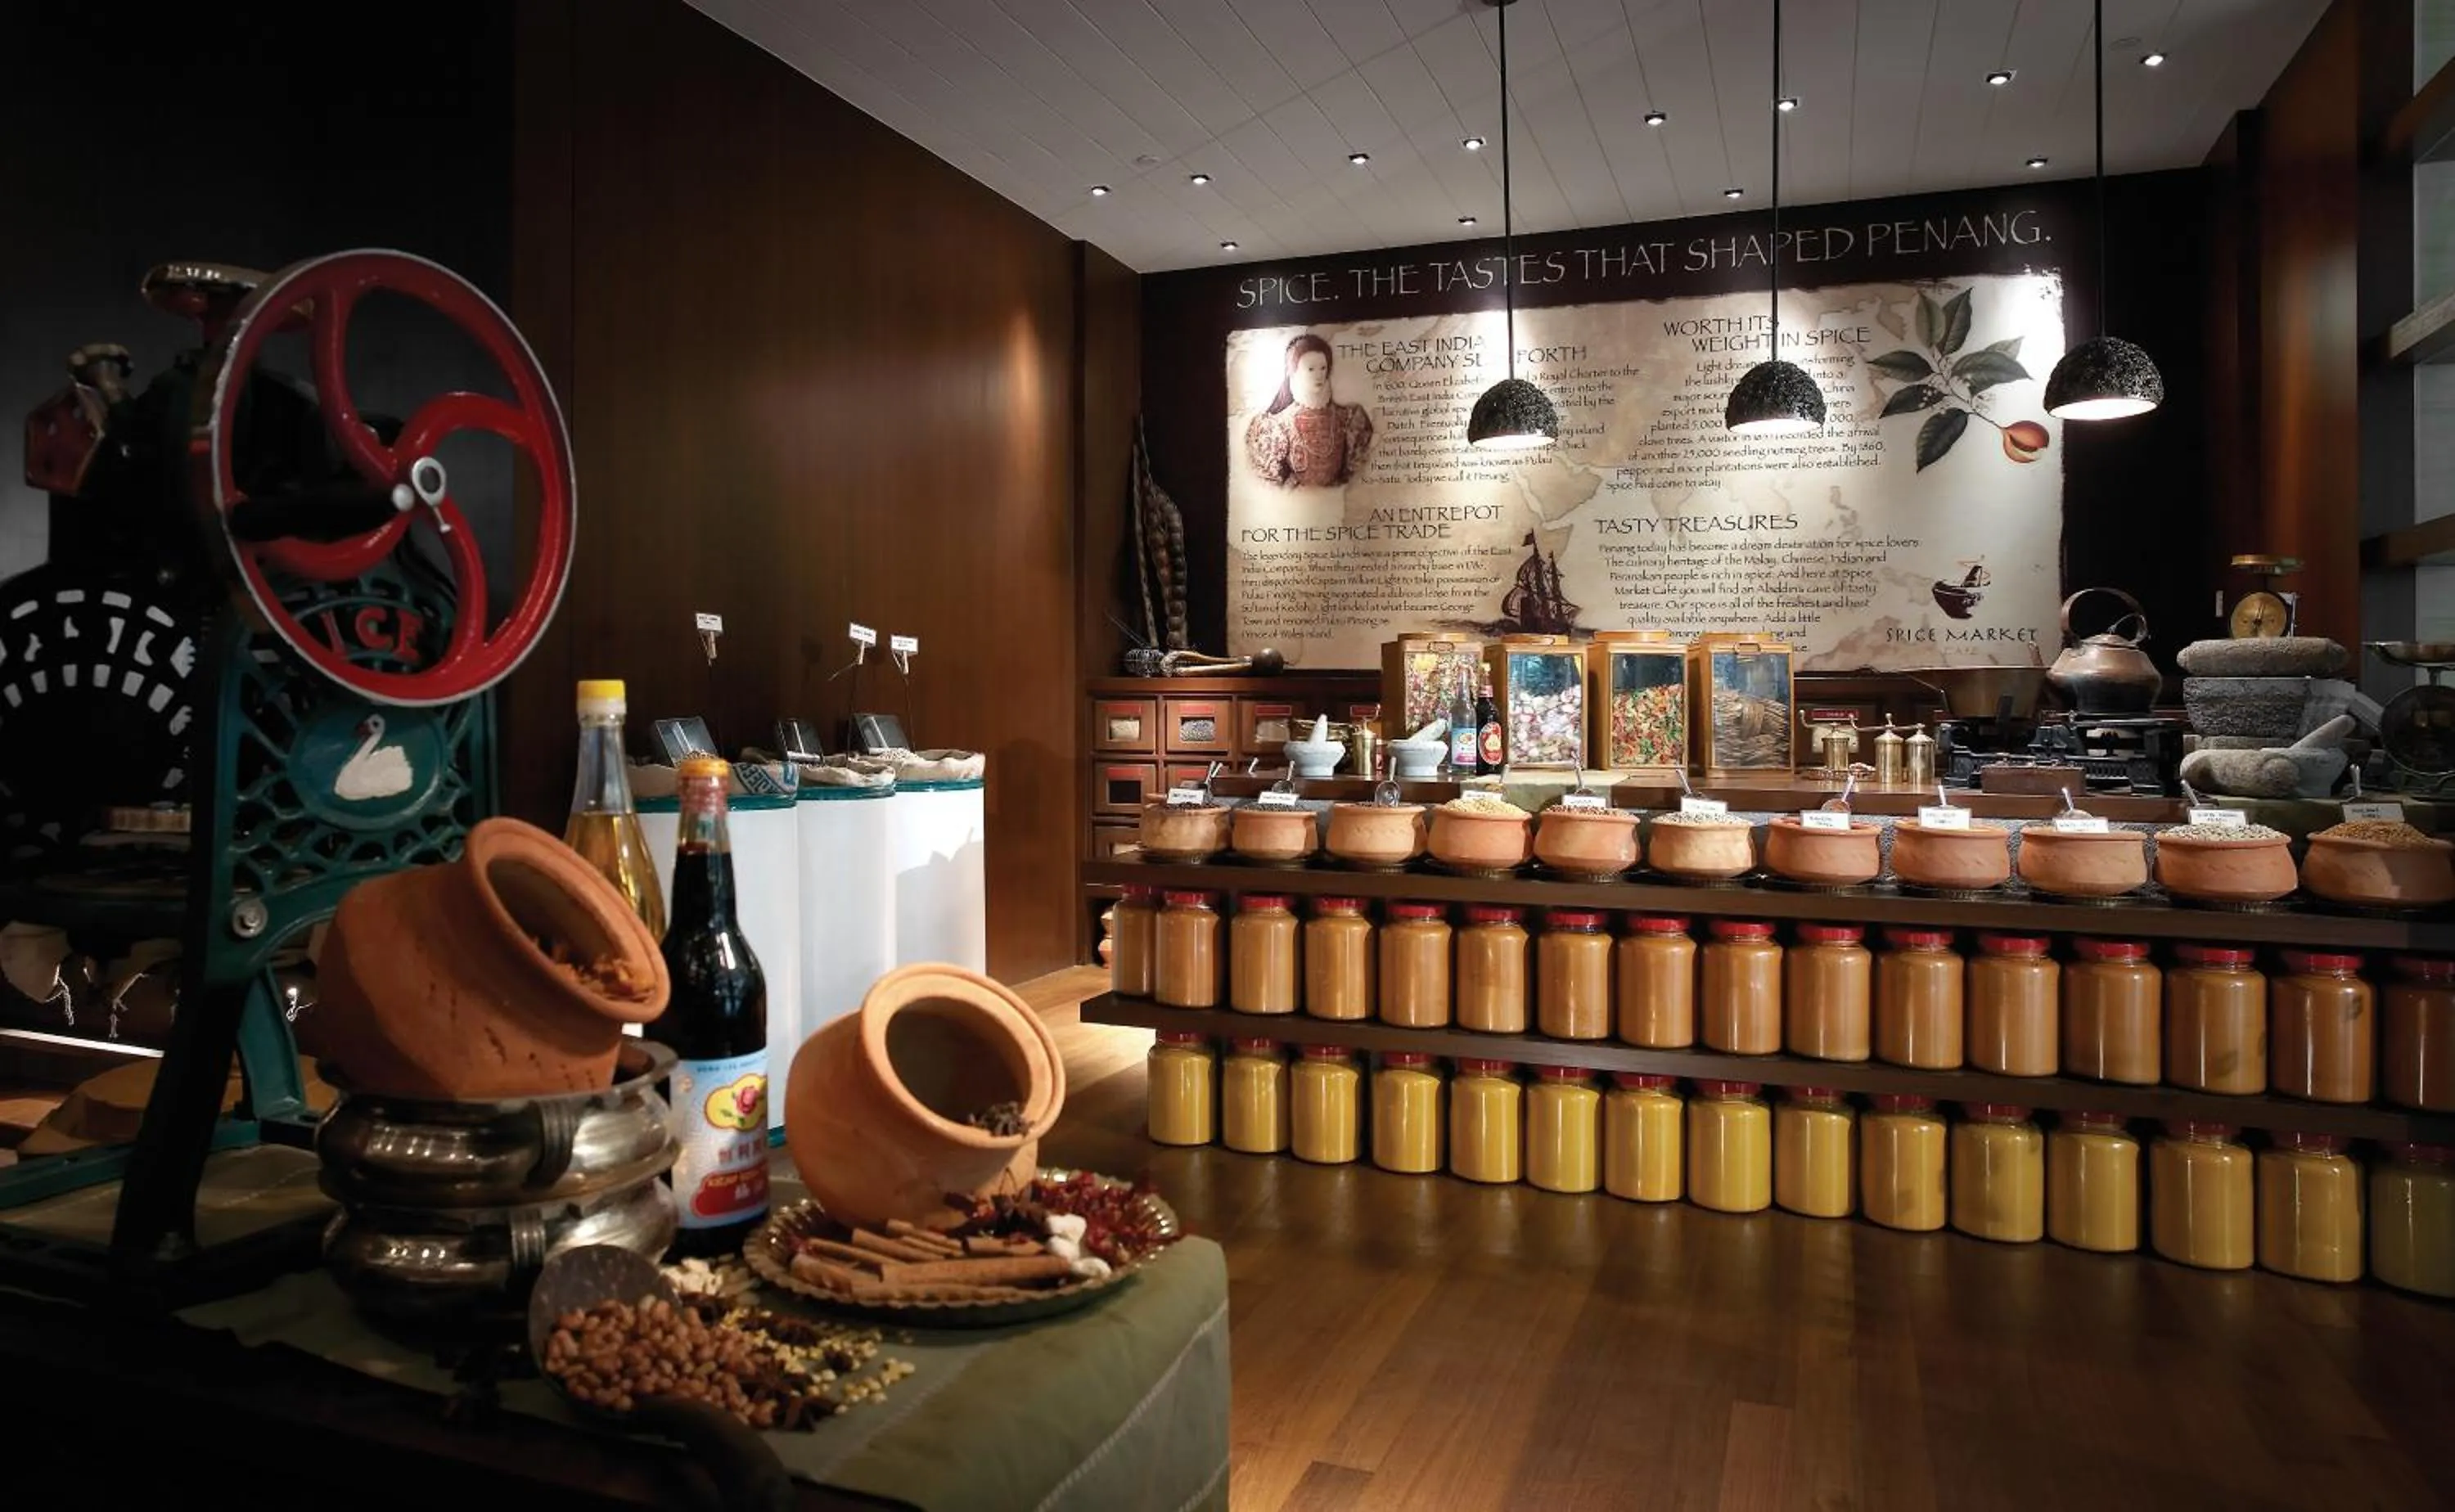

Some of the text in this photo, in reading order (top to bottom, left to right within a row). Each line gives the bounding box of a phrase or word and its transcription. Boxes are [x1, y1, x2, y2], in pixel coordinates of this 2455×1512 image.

[1237, 209, 2052, 308] SPICE. THE TASTES THAT SHAPED PENANG.
[1664, 317, 1742, 336] WORTH
[1337, 342, 1376, 359] THE
[1382, 338, 1430, 356] EAST
[1691, 326, 1872, 353] WEIGHT IN SPICE
[1367, 353, 1460, 373] COMPANY
[1517, 346, 1587, 363] FORTH
[1370, 505, 1503, 523] AN ENTREPOT
[1595, 514, 1798, 534] TASTY TREASURES
[1241, 524, 1452, 542] FOR THE SPICE TRADE
[1886, 628, 2039, 643] SPICE MARKET
